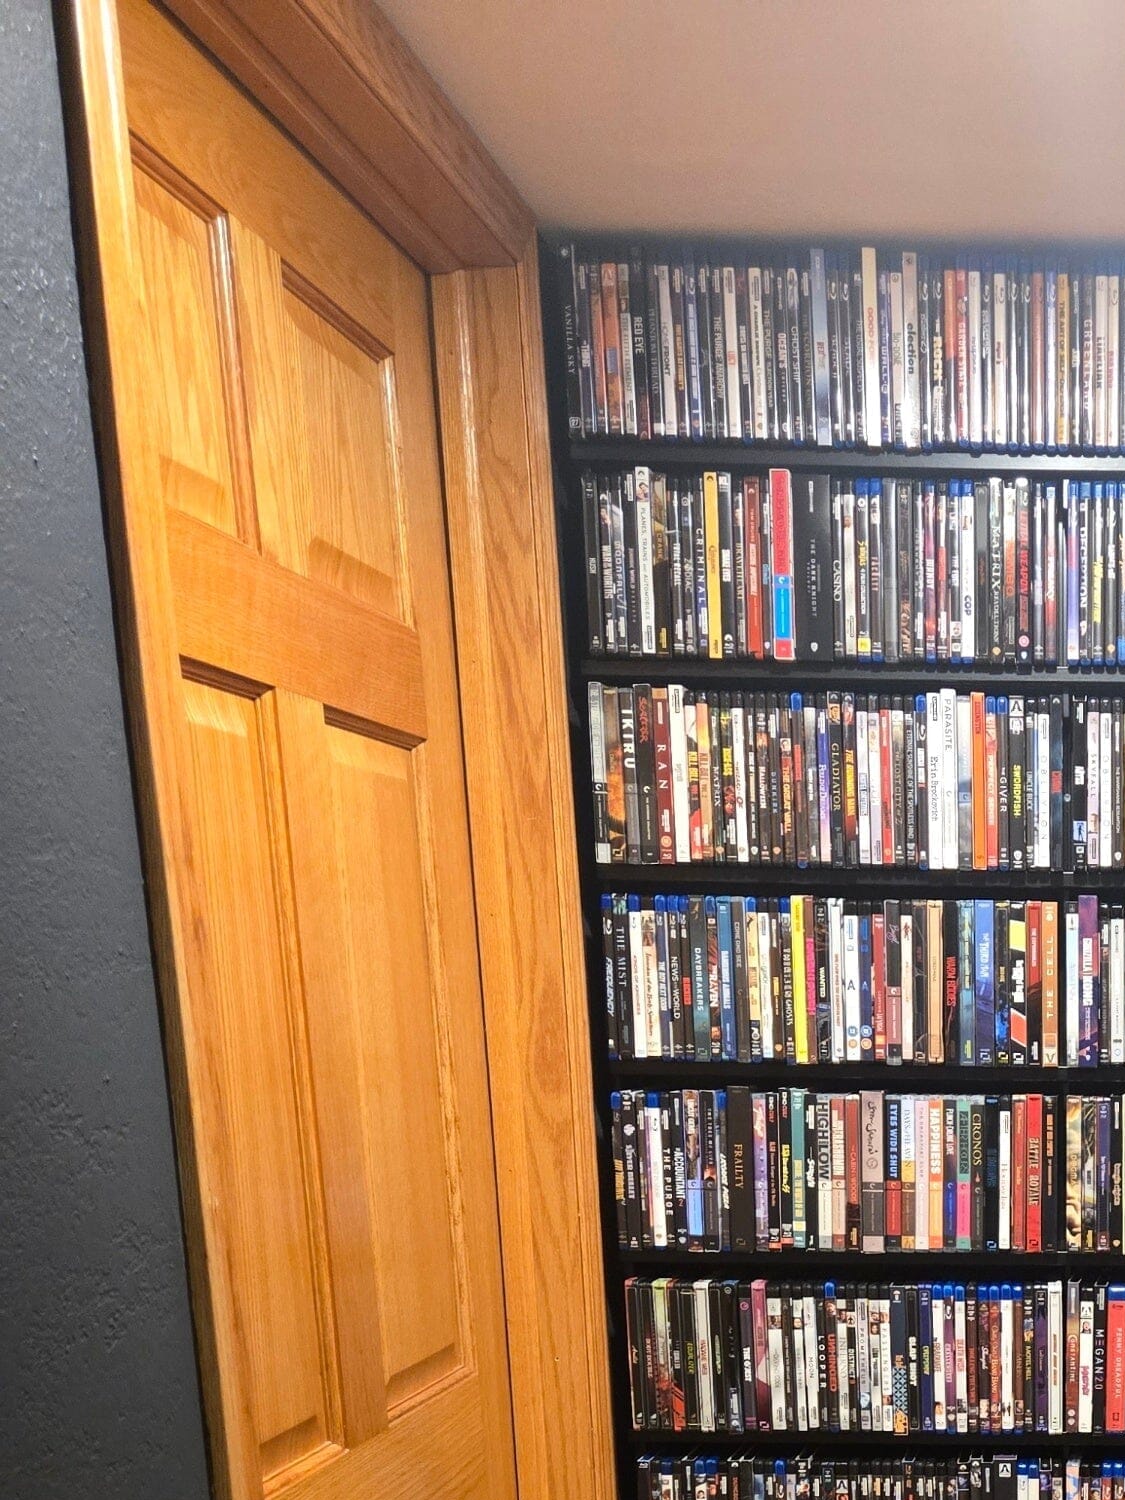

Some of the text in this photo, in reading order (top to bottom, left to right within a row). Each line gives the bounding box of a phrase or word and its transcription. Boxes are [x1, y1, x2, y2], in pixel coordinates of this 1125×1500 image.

[565, 305, 575, 374] VANILLA SKY
[634, 317, 644, 354] RED EYE
[907, 323, 916, 375] election
[933, 337, 943, 380] ROCK
[695, 528, 705, 604] CRIMINAL
[833, 560, 842, 601] CASINO
[964, 595, 972, 616] COP
[622, 708, 635, 769] IKIRU
[944, 699, 953, 751] PARASITE
[657, 744, 668, 789] RAN
[713, 766, 721, 807] MATRIX
[831, 743, 841, 811] GLADIATOR
[930, 756, 939, 822] Erin Brockovich
[1013, 764, 1021, 816] SWORDFISH
[999, 777, 1008, 813] GIVER
[616, 926, 627, 987] THE MIST
[694, 947, 704, 1011] DAYBREAKERS
[946, 956, 958, 1007] WARM BODIES
[606, 957, 615, 1017] FREQUENCY
[671, 956, 681, 1019] NEWS WORLD
[709, 974, 719, 1007] RAVEN
[817, 1102, 829, 1180] HIGH LOW
[889, 1104, 898, 1178] EYES WIDE SHUT
[930, 1108, 941, 1175] HAPPINESS
[972, 1113, 982, 1166] CRONOS
[1028, 1138, 1039, 1170] BATTLE
[663, 1148, 673, 1216] THE PURGE
[674, 1151, 685, 1199] ACCOUNTANT
[733, 1144, 744, 1189] FRAILTY
[818, 1335, 826, 1389] LOOPER
[828, 1333, 837, 1392] UNHINGED
[1115, 1328, 1123, 1354] PENNY
[909, 1362, 917, 1387] SHOT
